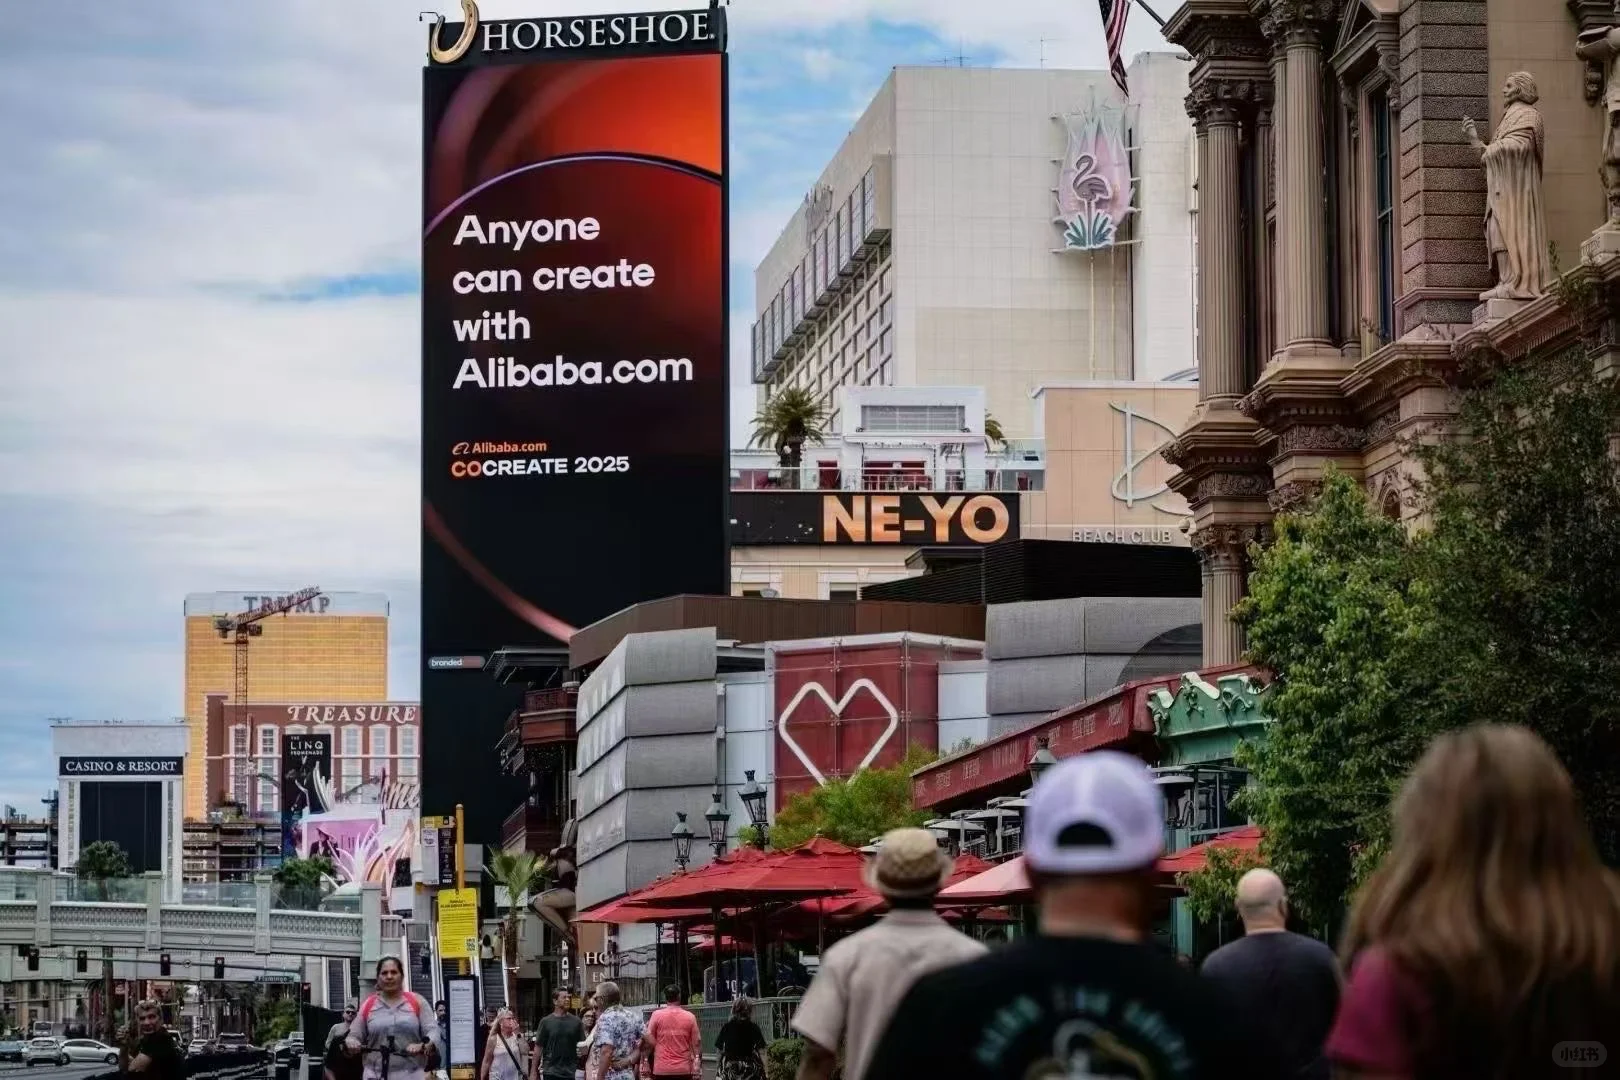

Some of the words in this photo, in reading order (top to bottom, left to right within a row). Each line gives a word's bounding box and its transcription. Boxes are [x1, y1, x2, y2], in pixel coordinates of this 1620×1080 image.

[481, 13, 710, 52] HORSESHOE
[453, 215, 600, 250] Anyone
[453, 268, 522, 294] can
[533, 258, 655, 291] create
[453, 309, 530, 342] with
[453, 355, 693, 389] Alibaba.com
[472, 441, 547, 454] Alibaba.com
[451, 458, 568, 477] COCREATE
[574, 456, 630, 473] 2025
[823, 495, 1009, 543] NE-YO
[1072, 528, 1125, 543] BEACH
[1131, 530, 1172, 544] CLUB
[431, 658, 463, 667] branded
[287, 705, 416, 724] TREASURE
[290, 741, 323, 750] LINQ
[65, 761, 114, 772] CASINO
[116, 761, 126, 772] &
[128, 761, 177, 772] RESORT
